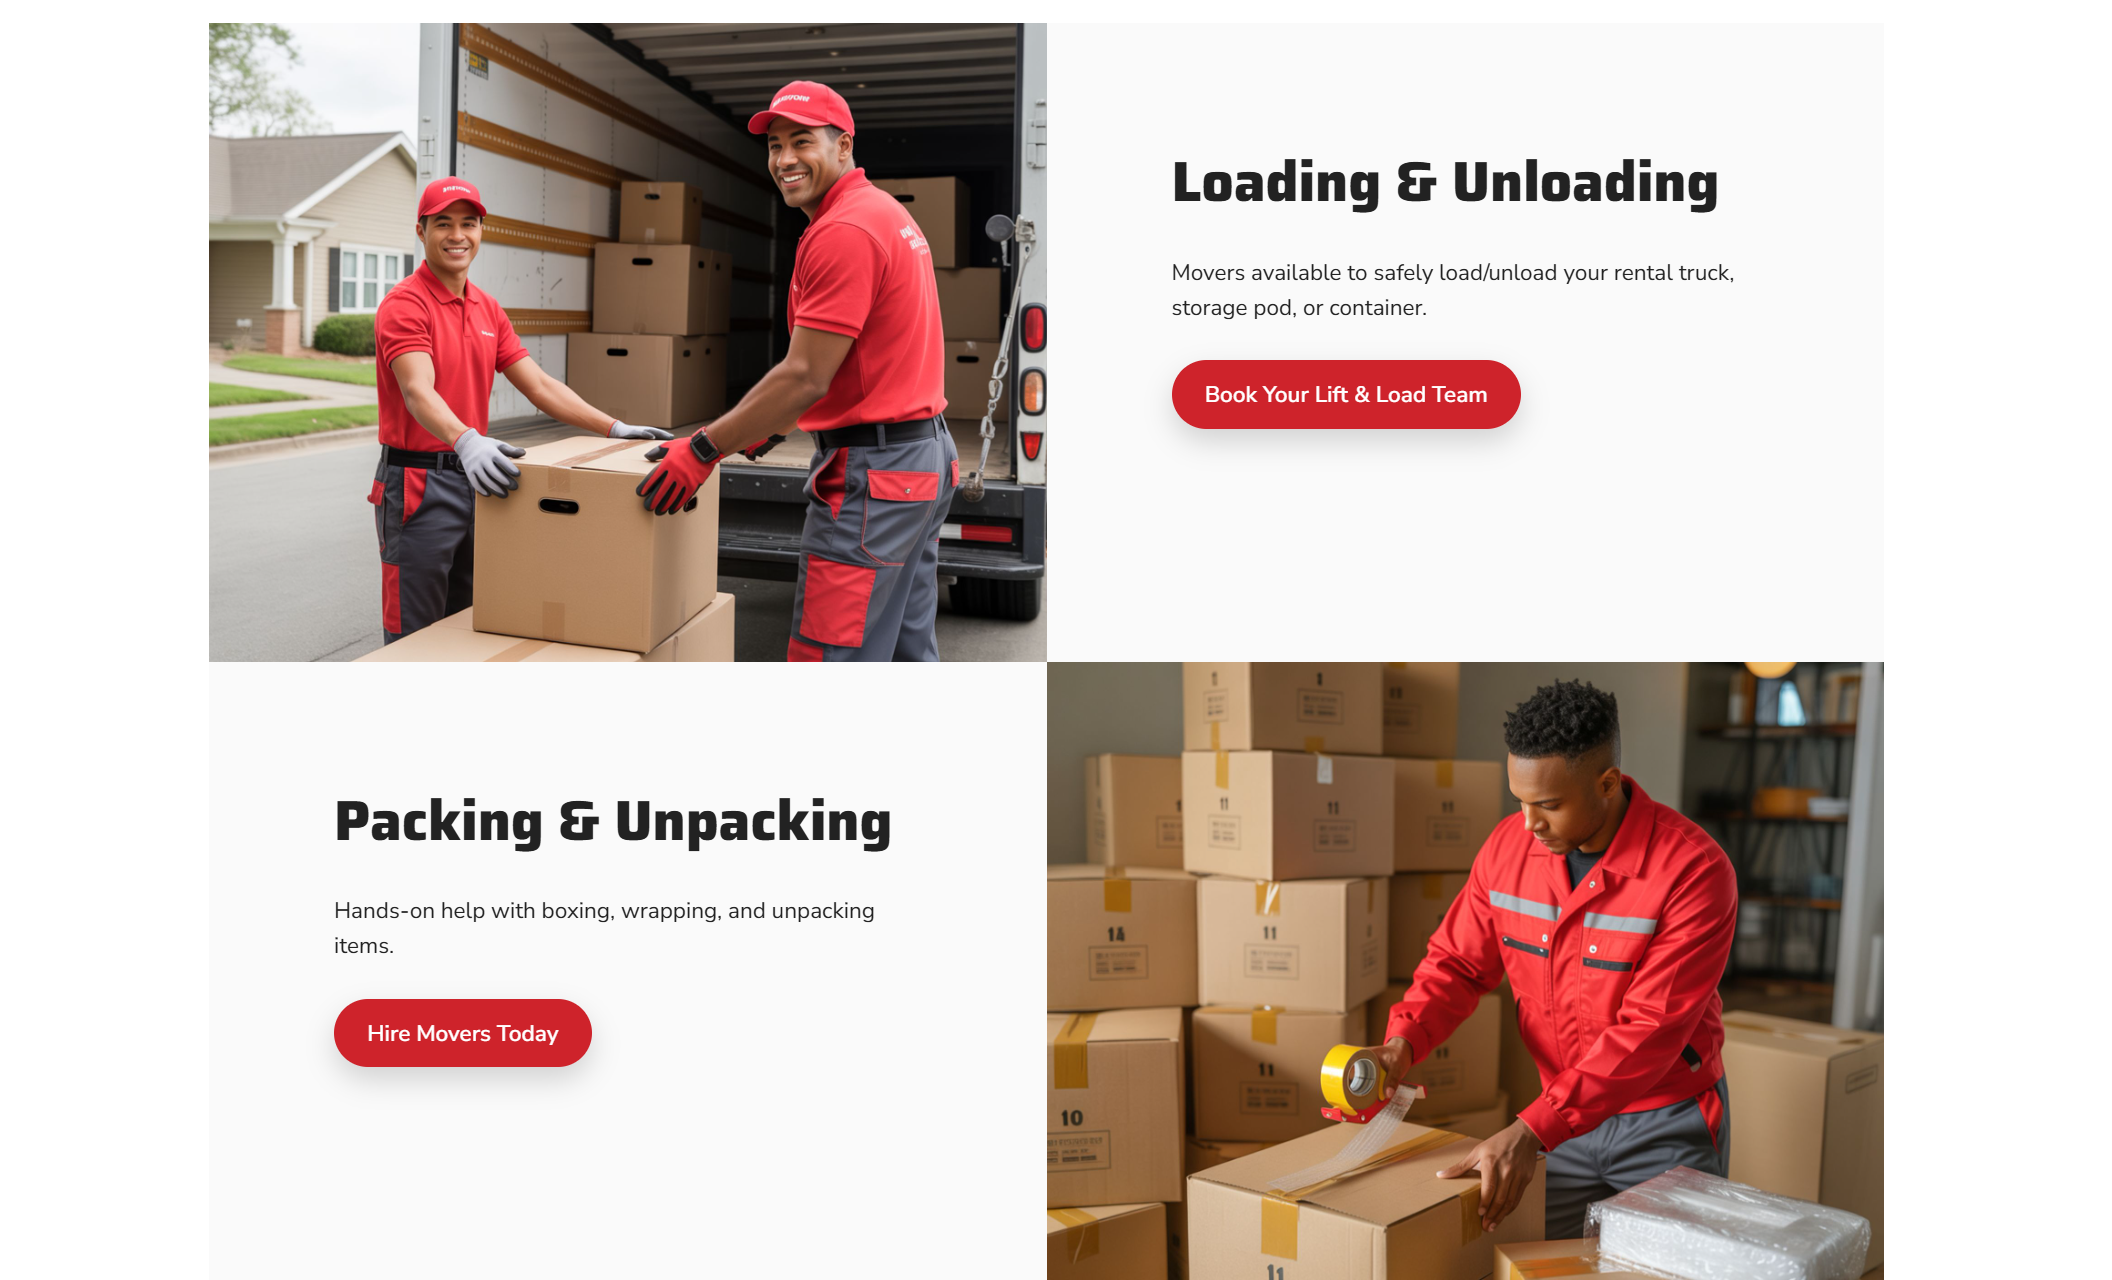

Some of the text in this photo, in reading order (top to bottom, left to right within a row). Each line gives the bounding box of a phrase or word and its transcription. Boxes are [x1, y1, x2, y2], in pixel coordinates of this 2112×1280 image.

[1107, 926, 1125, 942] 14
[1263, 926, 1277, 940] 11
[1259, 1062, 1274, 1077] 11
[1061, 1109, 1083, 1126] 10
